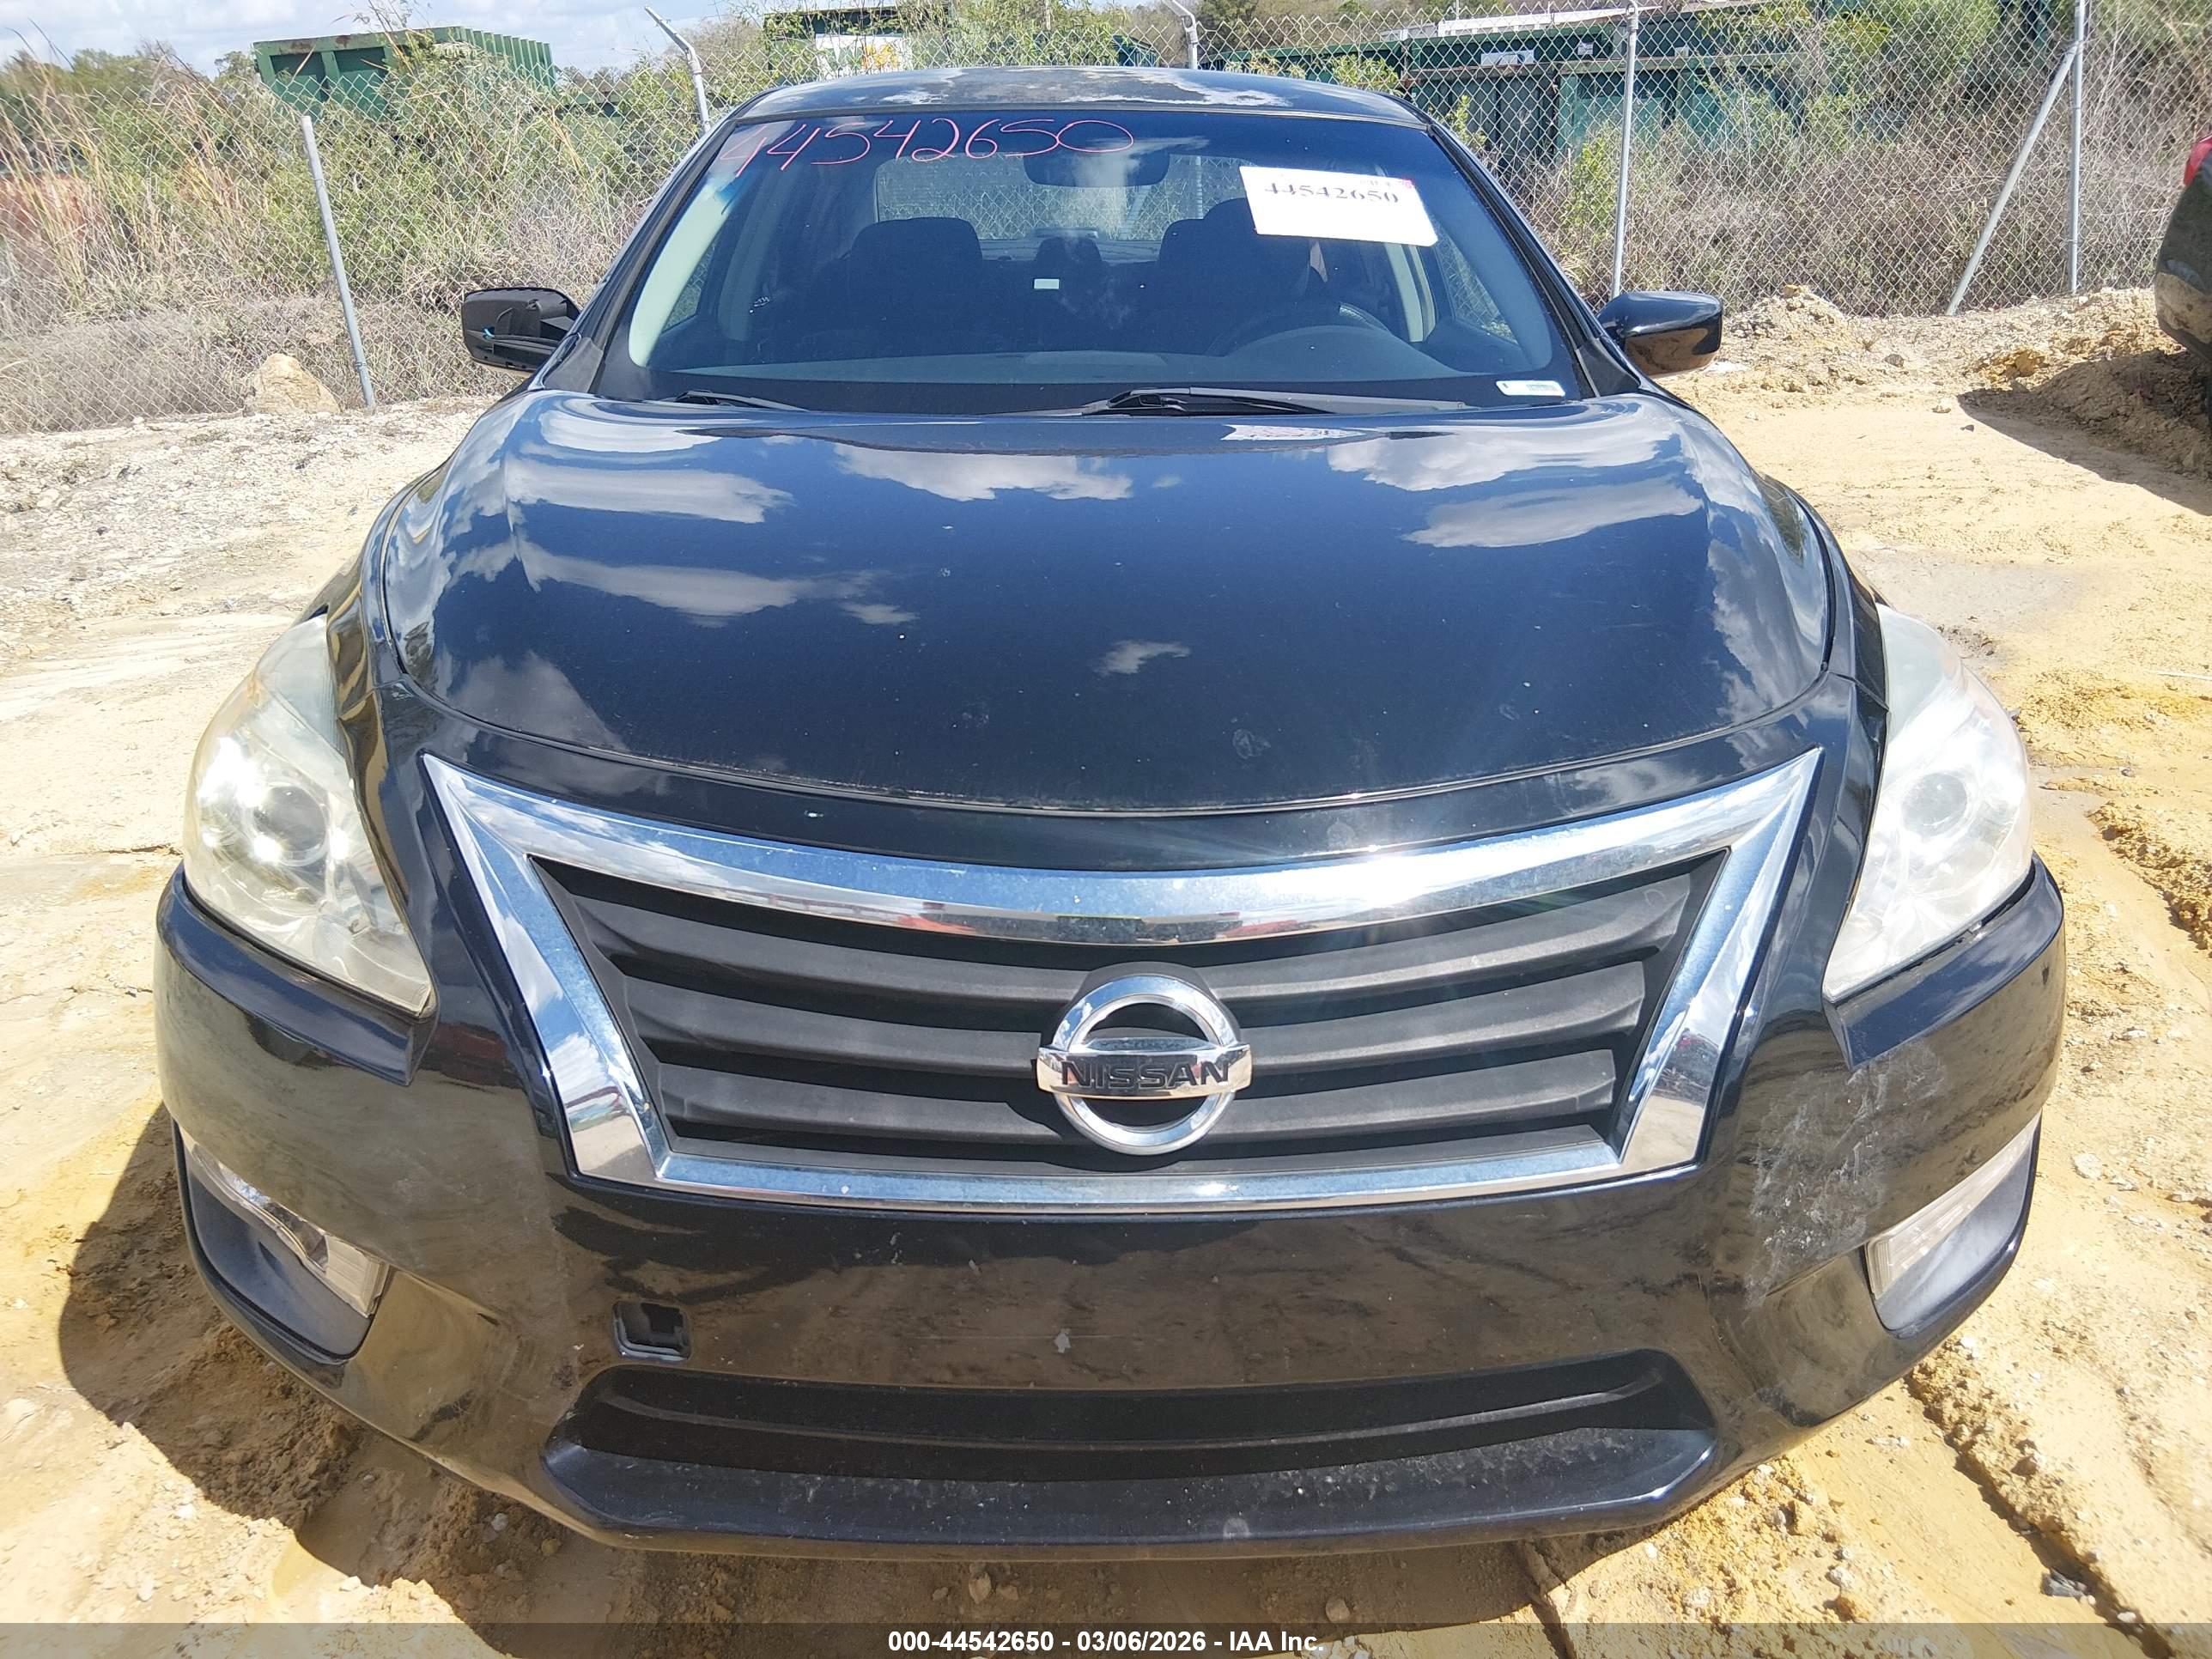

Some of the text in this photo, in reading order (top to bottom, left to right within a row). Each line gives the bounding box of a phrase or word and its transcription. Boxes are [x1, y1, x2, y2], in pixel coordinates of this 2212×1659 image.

[720, 118, 1133, 178] 44542650
[1264, 182, 1399, 204] 44542650
[1061, 1060, 1229, 1090] NISSAN
